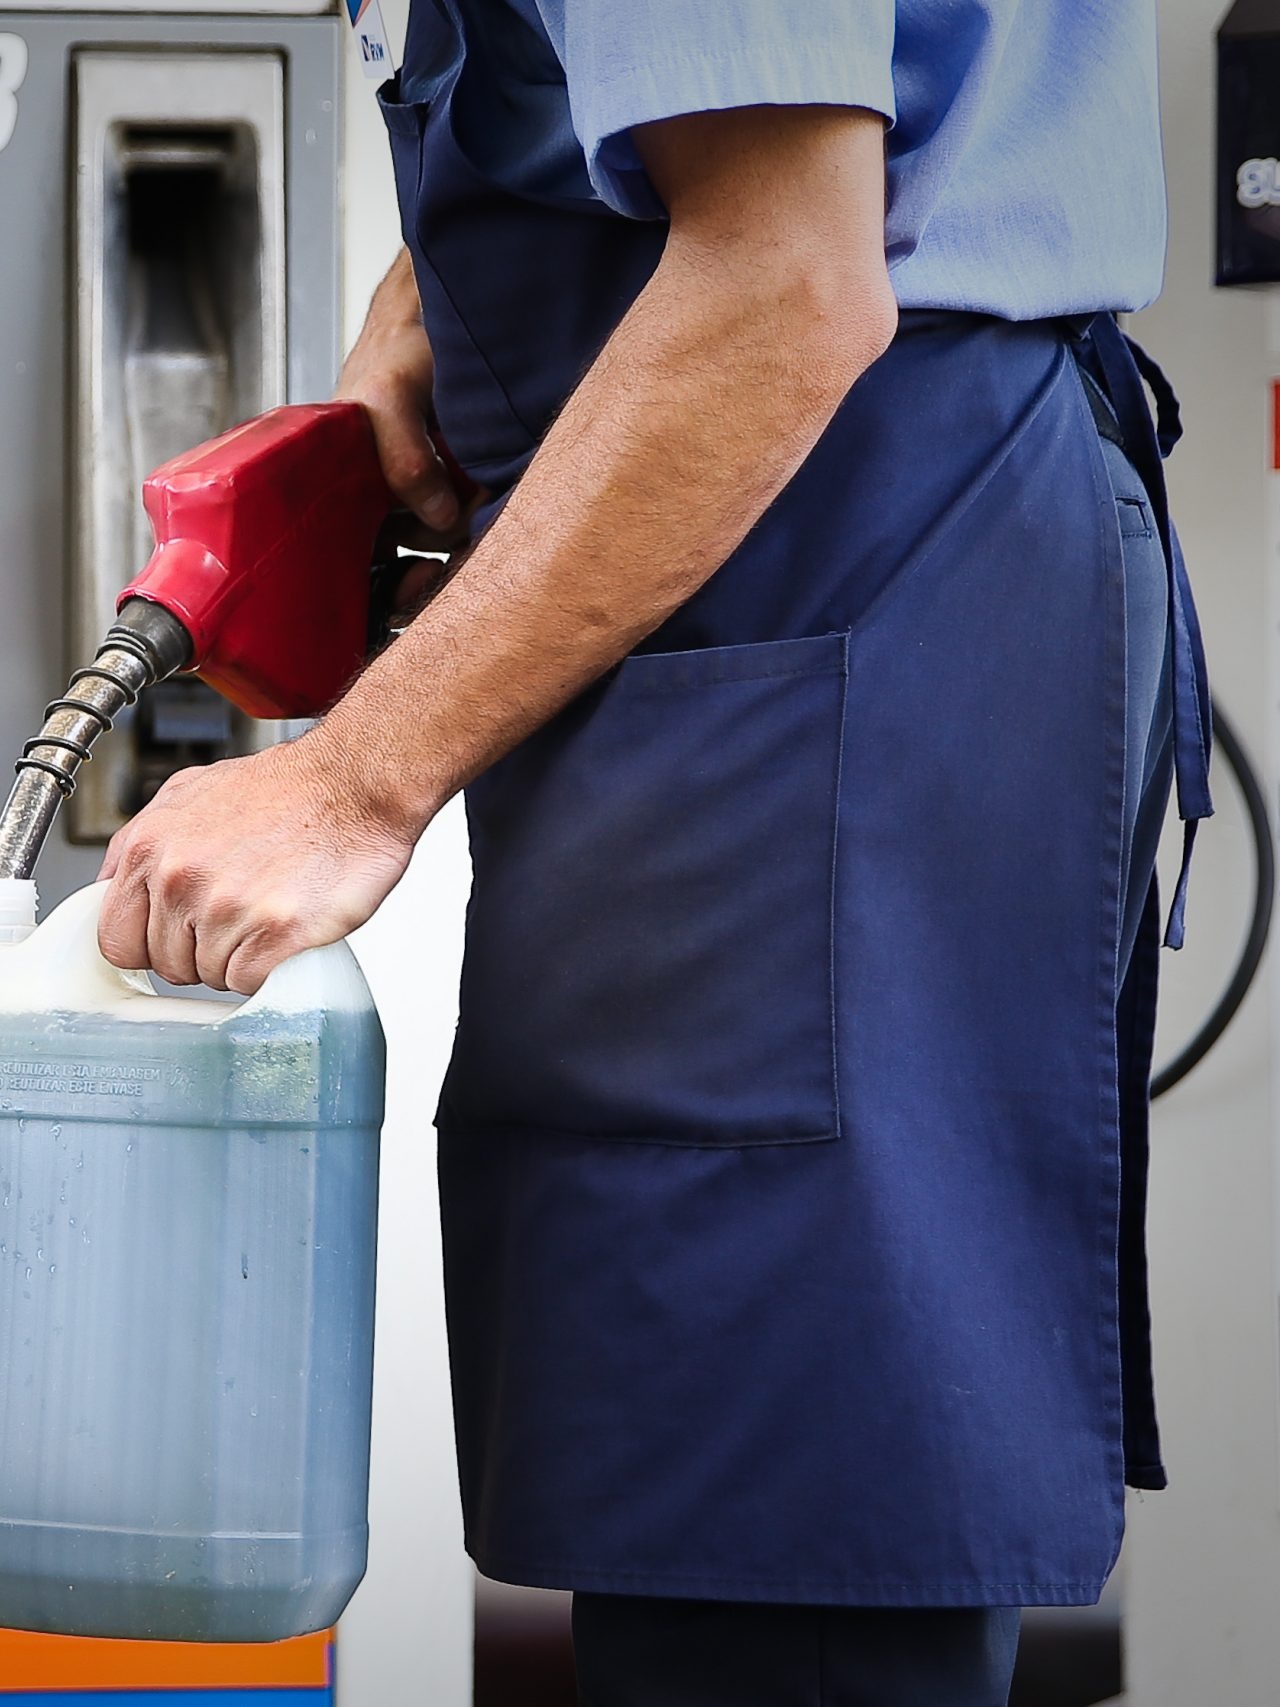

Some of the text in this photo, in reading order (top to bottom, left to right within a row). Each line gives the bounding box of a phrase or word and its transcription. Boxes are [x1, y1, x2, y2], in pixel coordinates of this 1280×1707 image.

[0, 1060, 60, 1077] REUTILIZAR
[93, 1065, 161, 1081] EMBALAGEM
[7, 1077, 66, 1092] REUTILIZAR
[69, 1080, 96, 1094] ESTE
[99, 1081, 143, 1096] ENVASE
